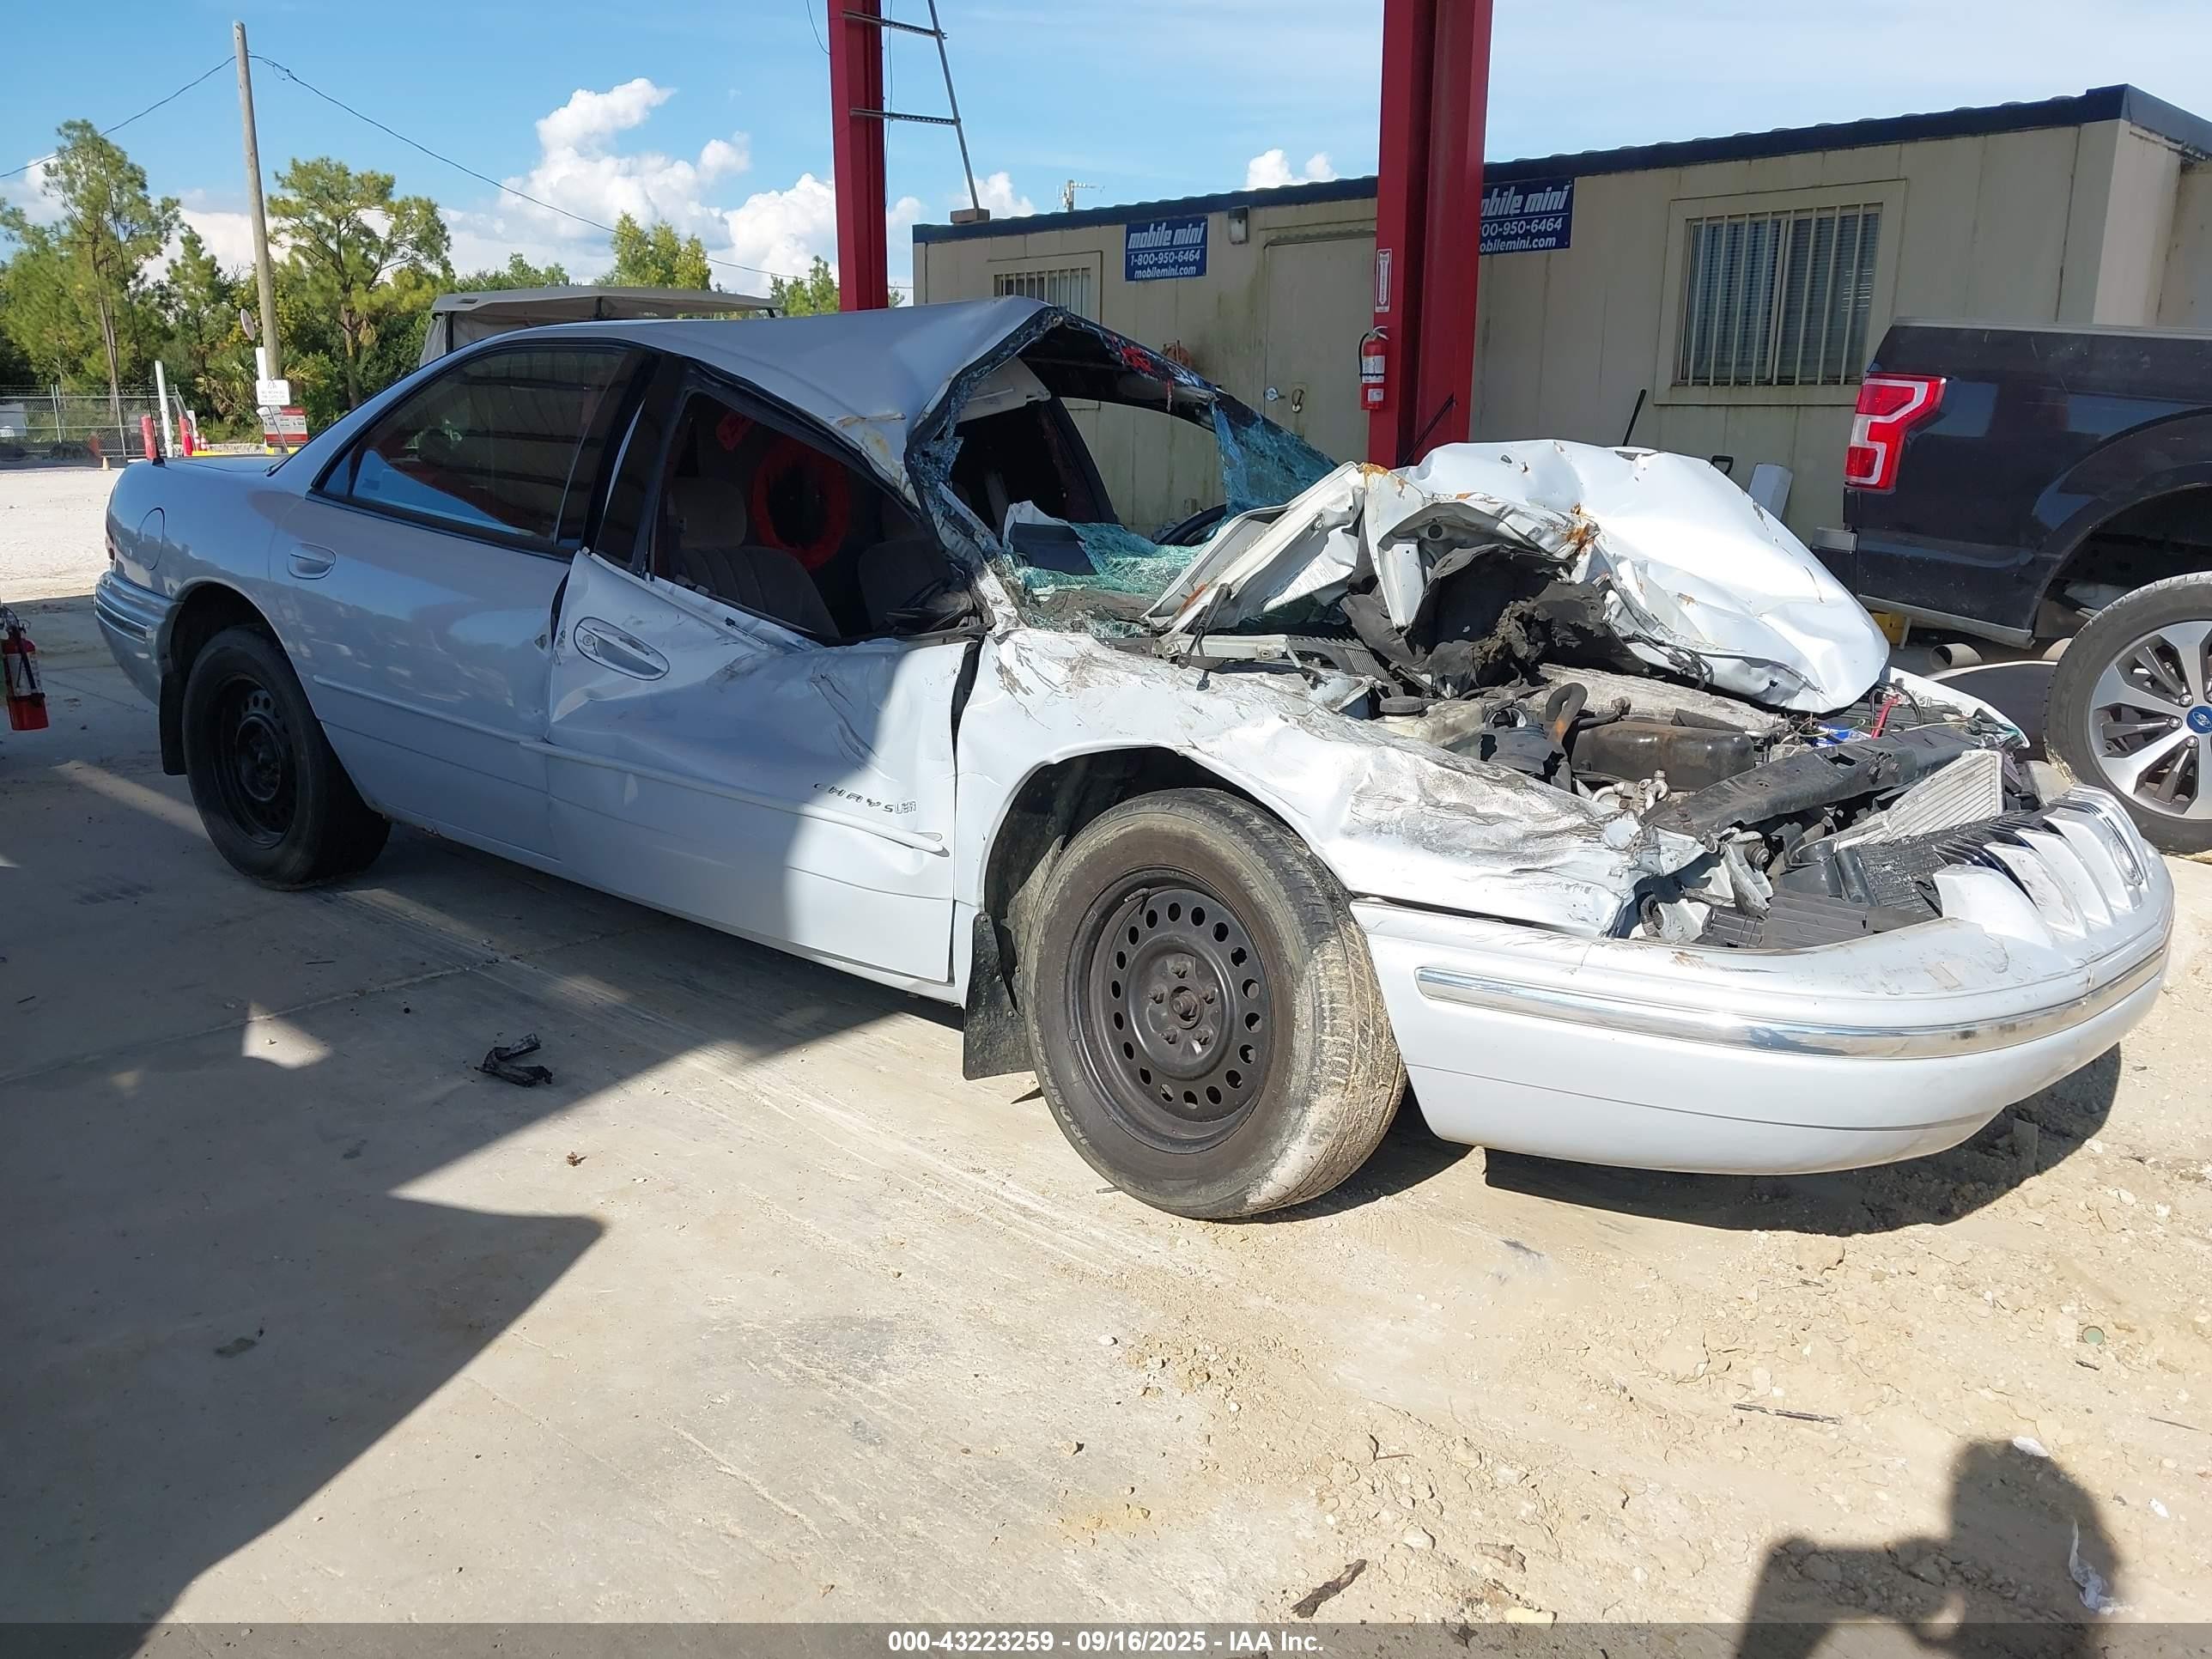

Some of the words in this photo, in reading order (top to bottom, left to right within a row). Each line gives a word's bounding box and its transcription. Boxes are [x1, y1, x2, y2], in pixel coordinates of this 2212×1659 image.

[1480, 186, 1523, 216] obile
[1523, 185, 1570, 213] mini
[1127, 222, 1172, 248] mobile
[1172, 222, 1206, 245] mini
[1480, 217, 1563, 237] 00-950-6464
[1480, 236, 1556, 252] obilemini.com
[1130, 249, 1200, 266] 1-800-950-6464
[1134, 264, 1196, 278] mobilemini.com
[813, 783, 916, 814] CHRYSLER
